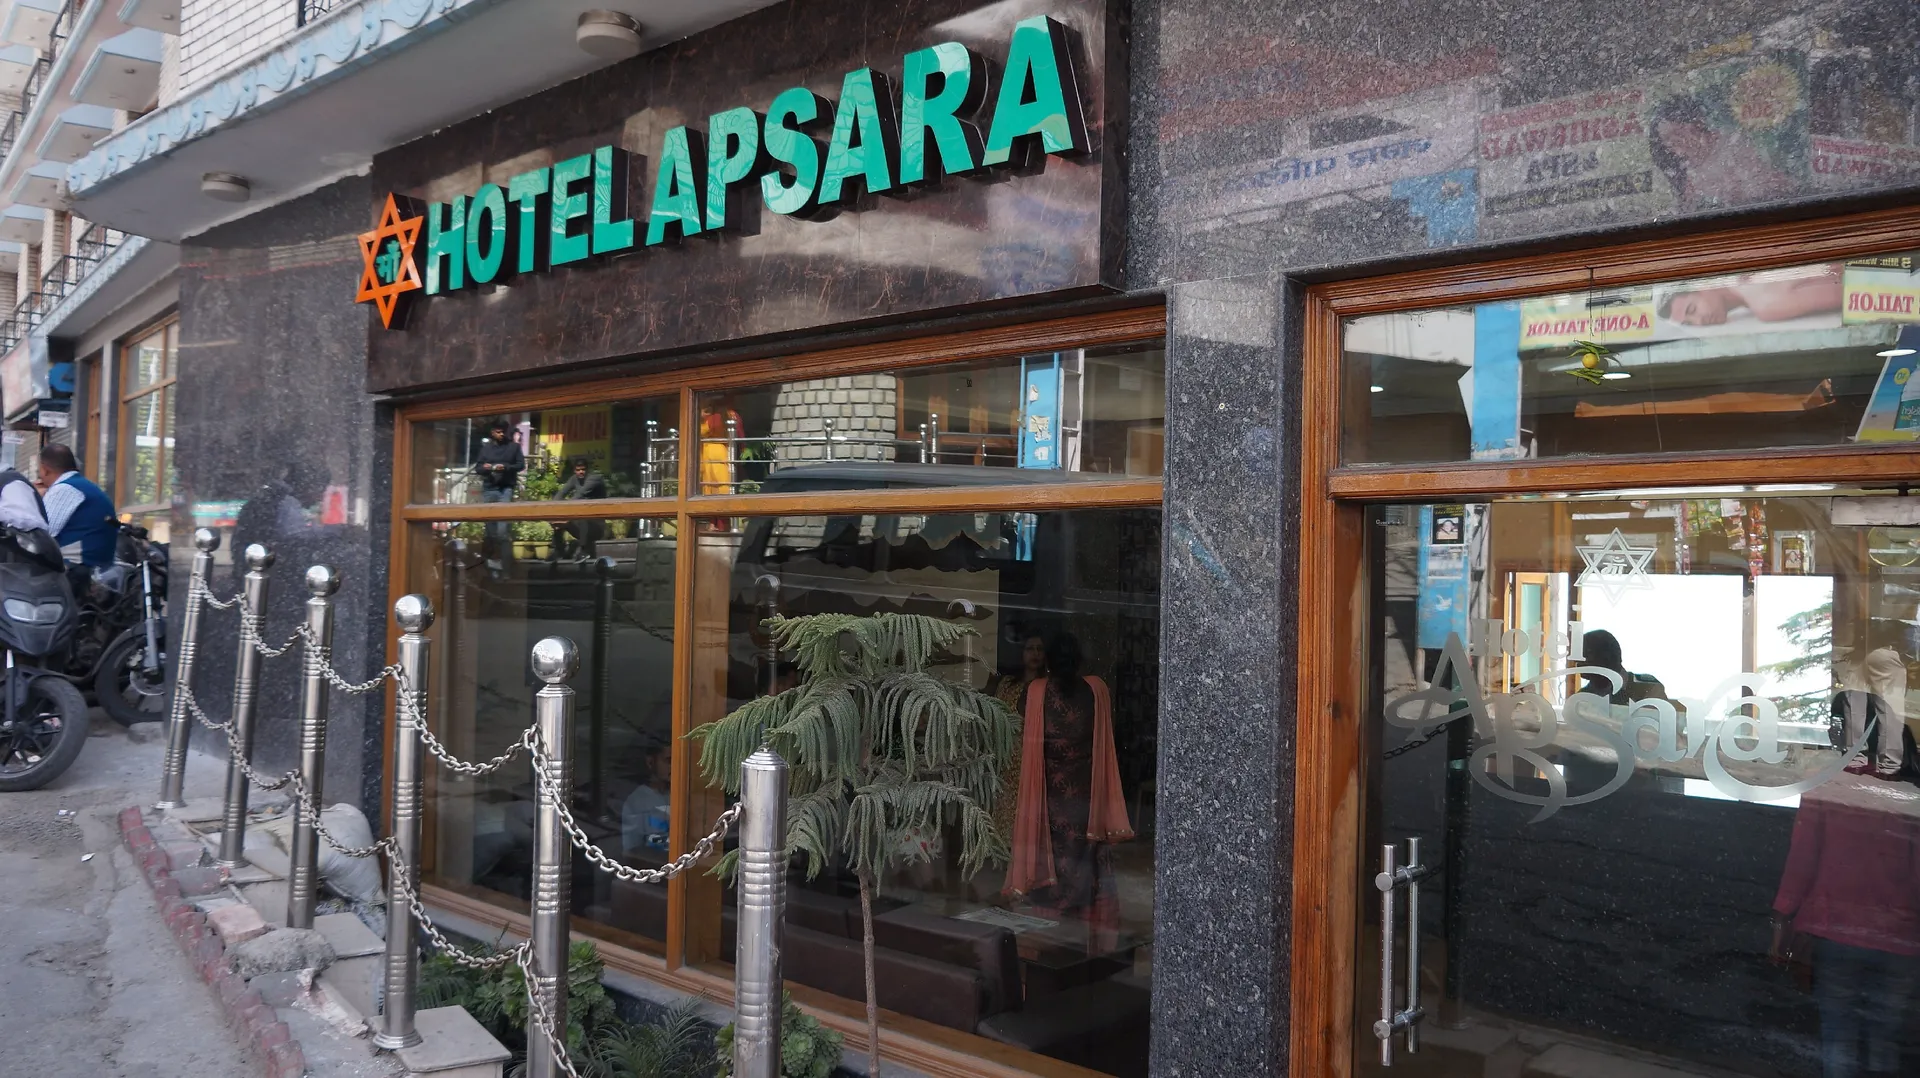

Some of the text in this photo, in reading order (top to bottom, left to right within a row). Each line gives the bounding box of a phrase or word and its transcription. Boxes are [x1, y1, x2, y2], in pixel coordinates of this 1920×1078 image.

[426, 14, 1078, 296] HOTEL APSARA
[1384, 631, 1878, 824] Apsara
[1469, 618, 1587, 663] Hotel
